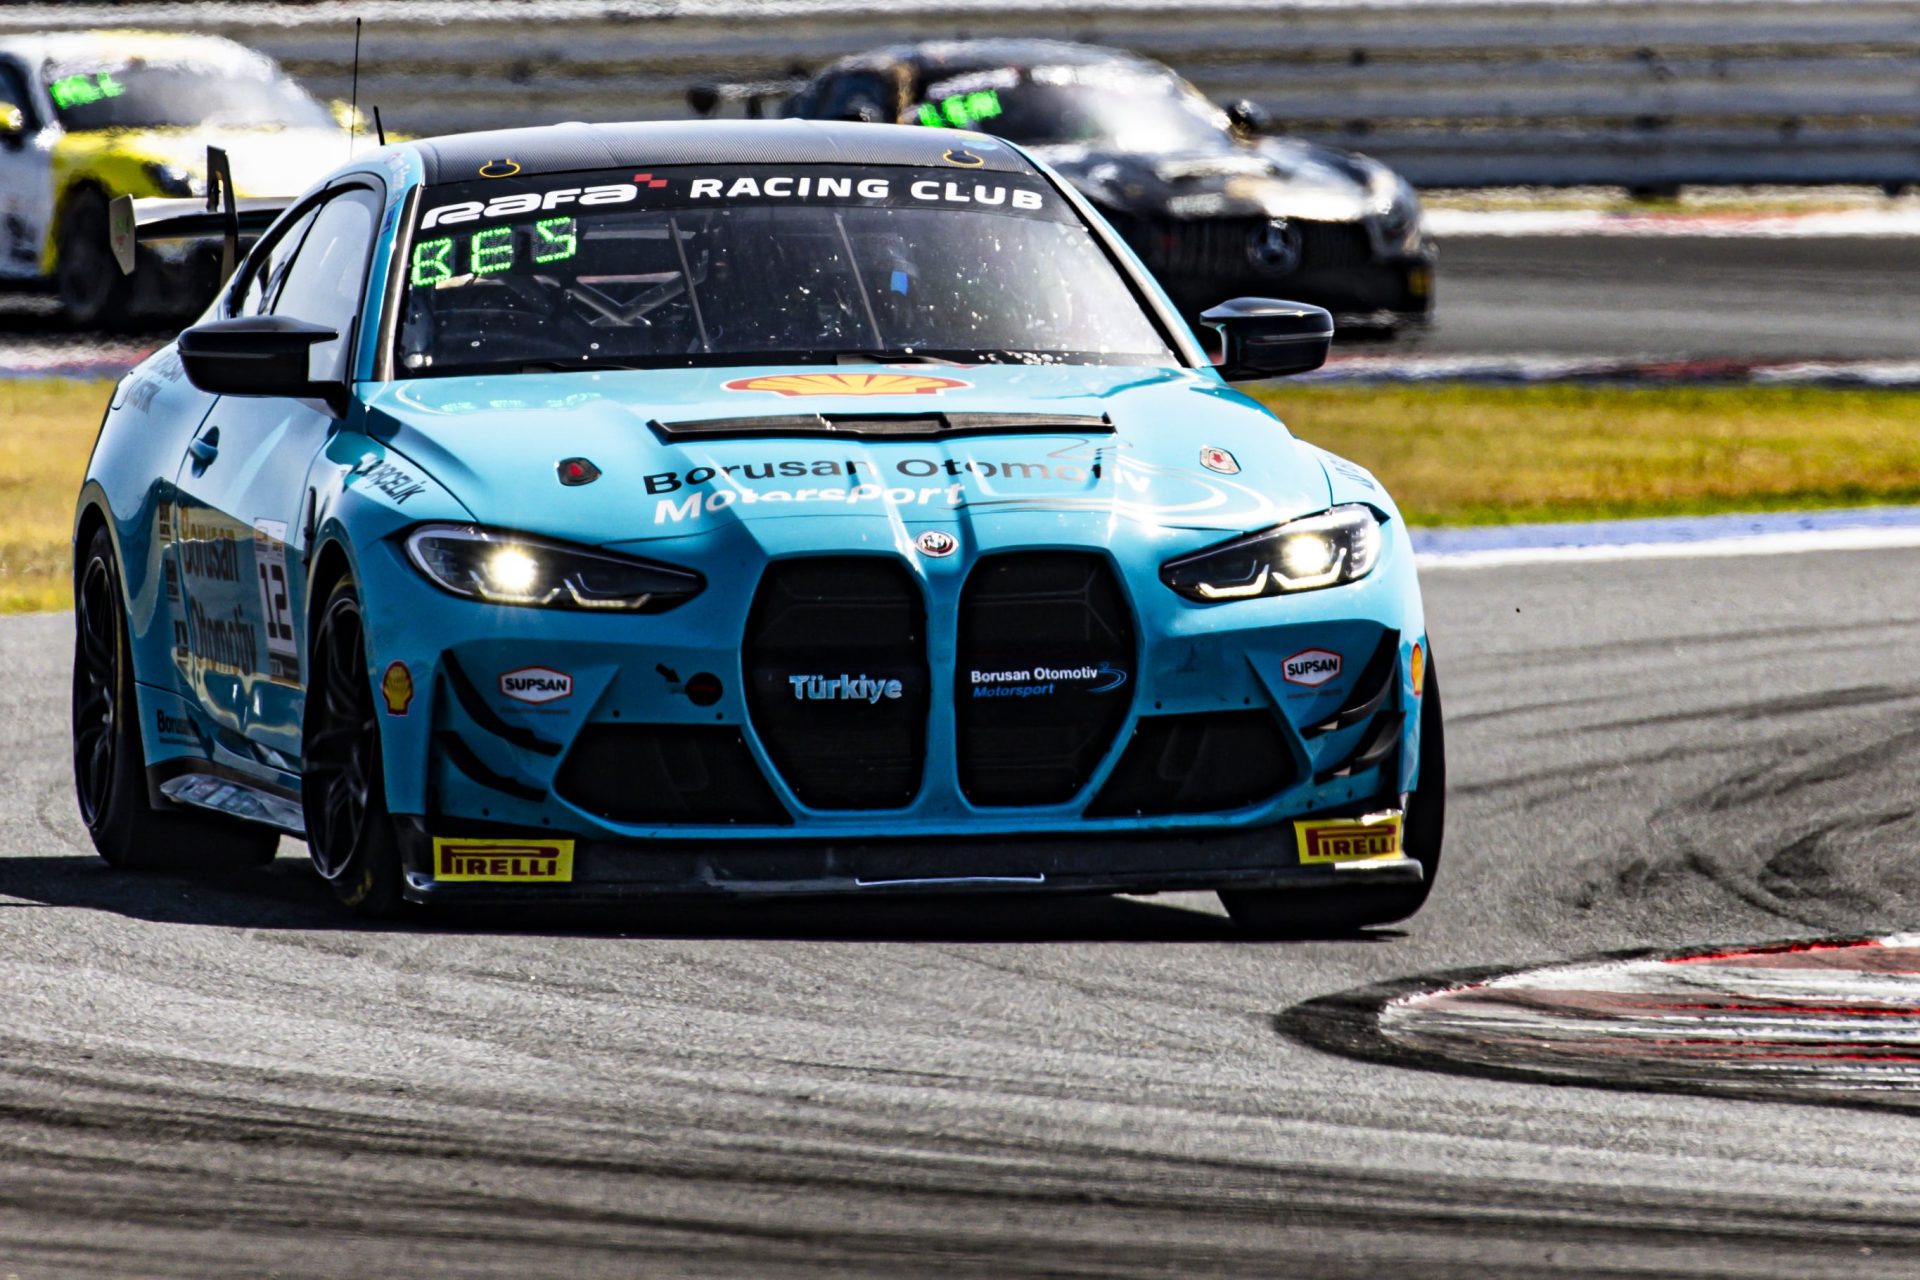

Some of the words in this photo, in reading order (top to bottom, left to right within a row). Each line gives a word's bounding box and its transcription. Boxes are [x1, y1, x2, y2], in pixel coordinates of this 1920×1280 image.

[689, 177, 890, 199] RACING
[910, 181, 1043, 210] CLUB
[643, 460, 877, 495] Borusan
[259, 563, 292, 640] 12
[971, 670, 1030, 683] Borusan
[1034, 666, 1098, 681] Otomotiv
[1287, 658, 1338, 676] SUPSAN
[505, 678, 567, 691] SUPSAN
[789, 674, 902, 704] Türkiye
[973, 683, 1054, 698] Motorsport
[1305, 824, 1397, 857] PIRELLI
[440, 845, 560, 876] PIRELLI
